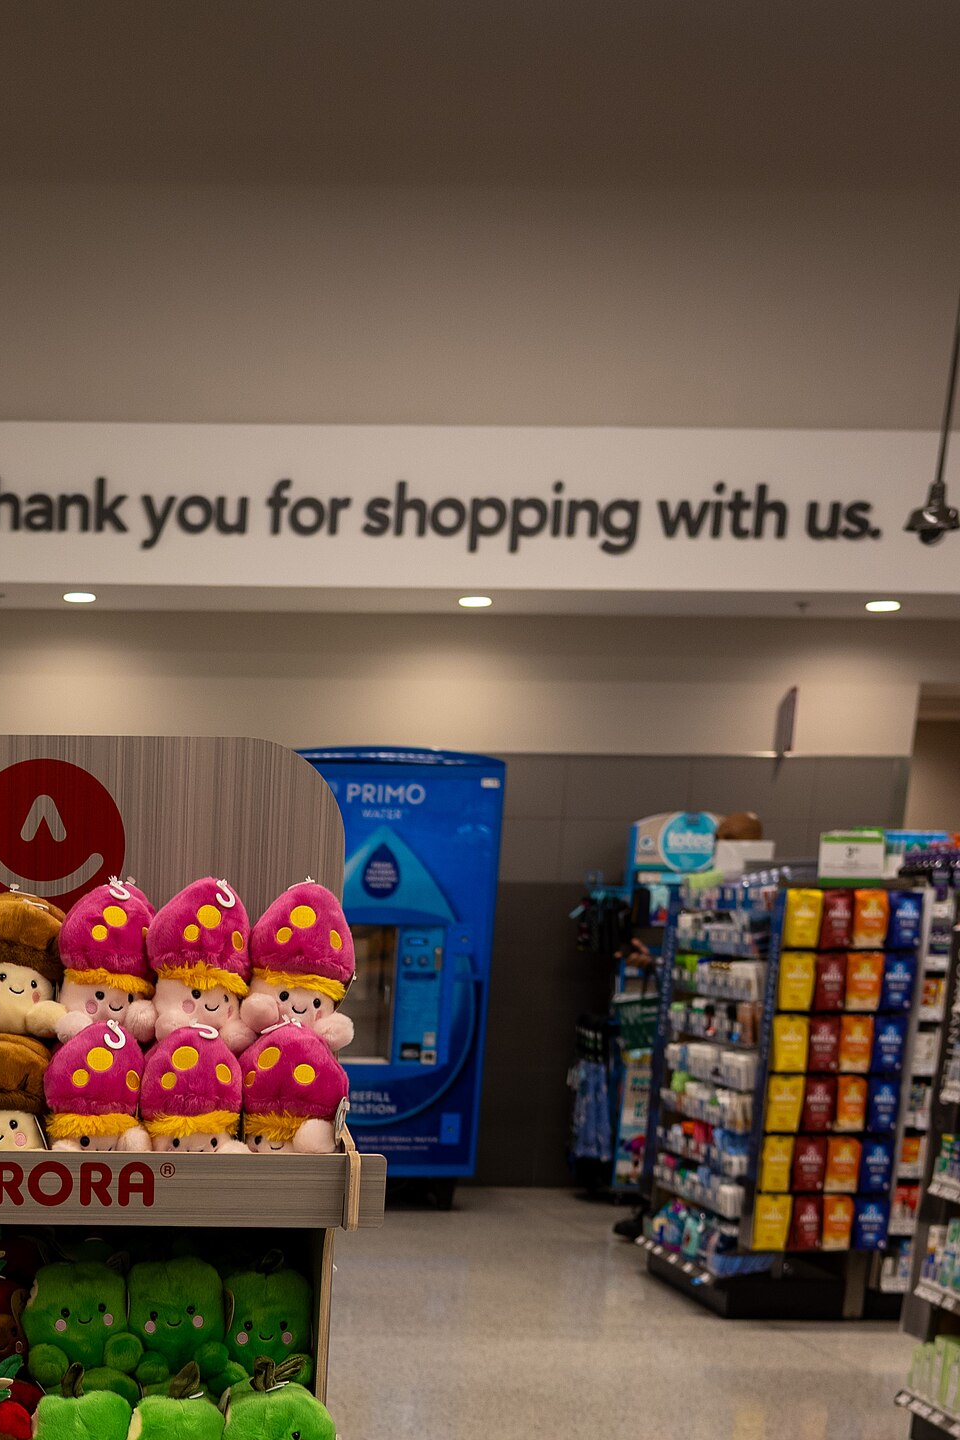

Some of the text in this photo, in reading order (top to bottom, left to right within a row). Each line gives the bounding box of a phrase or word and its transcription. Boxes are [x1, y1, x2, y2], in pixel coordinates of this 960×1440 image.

[141, 495, 249, 550] you
[267, 479, 352, 537] for
[362, 481, 641, 555] shopping
[657, 483, 788, 541] with
[804, 494, 883, 542] us.
[346, 782, 427, 806] PRIMO
[361, 808, 403, 820] WATER
[351, 1103, 398, 1116] TATION
